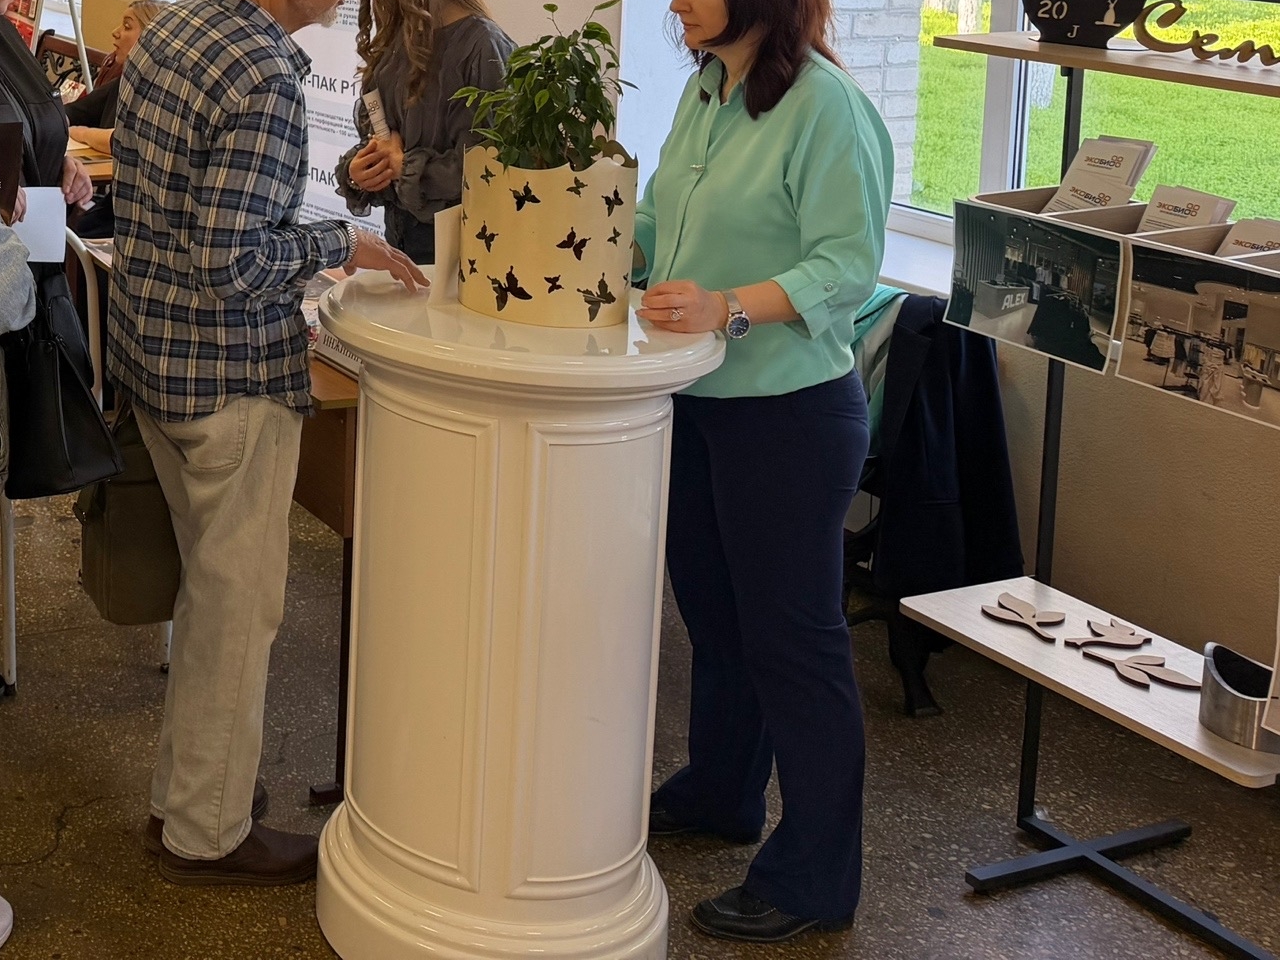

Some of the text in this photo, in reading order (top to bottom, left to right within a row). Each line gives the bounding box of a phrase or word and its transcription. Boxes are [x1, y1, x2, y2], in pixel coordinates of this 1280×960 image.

[1037, 0, 1069, 20] 20
[1067, 25, 1080, 39] J
[1001, 292, 1026, 310] ALEX
